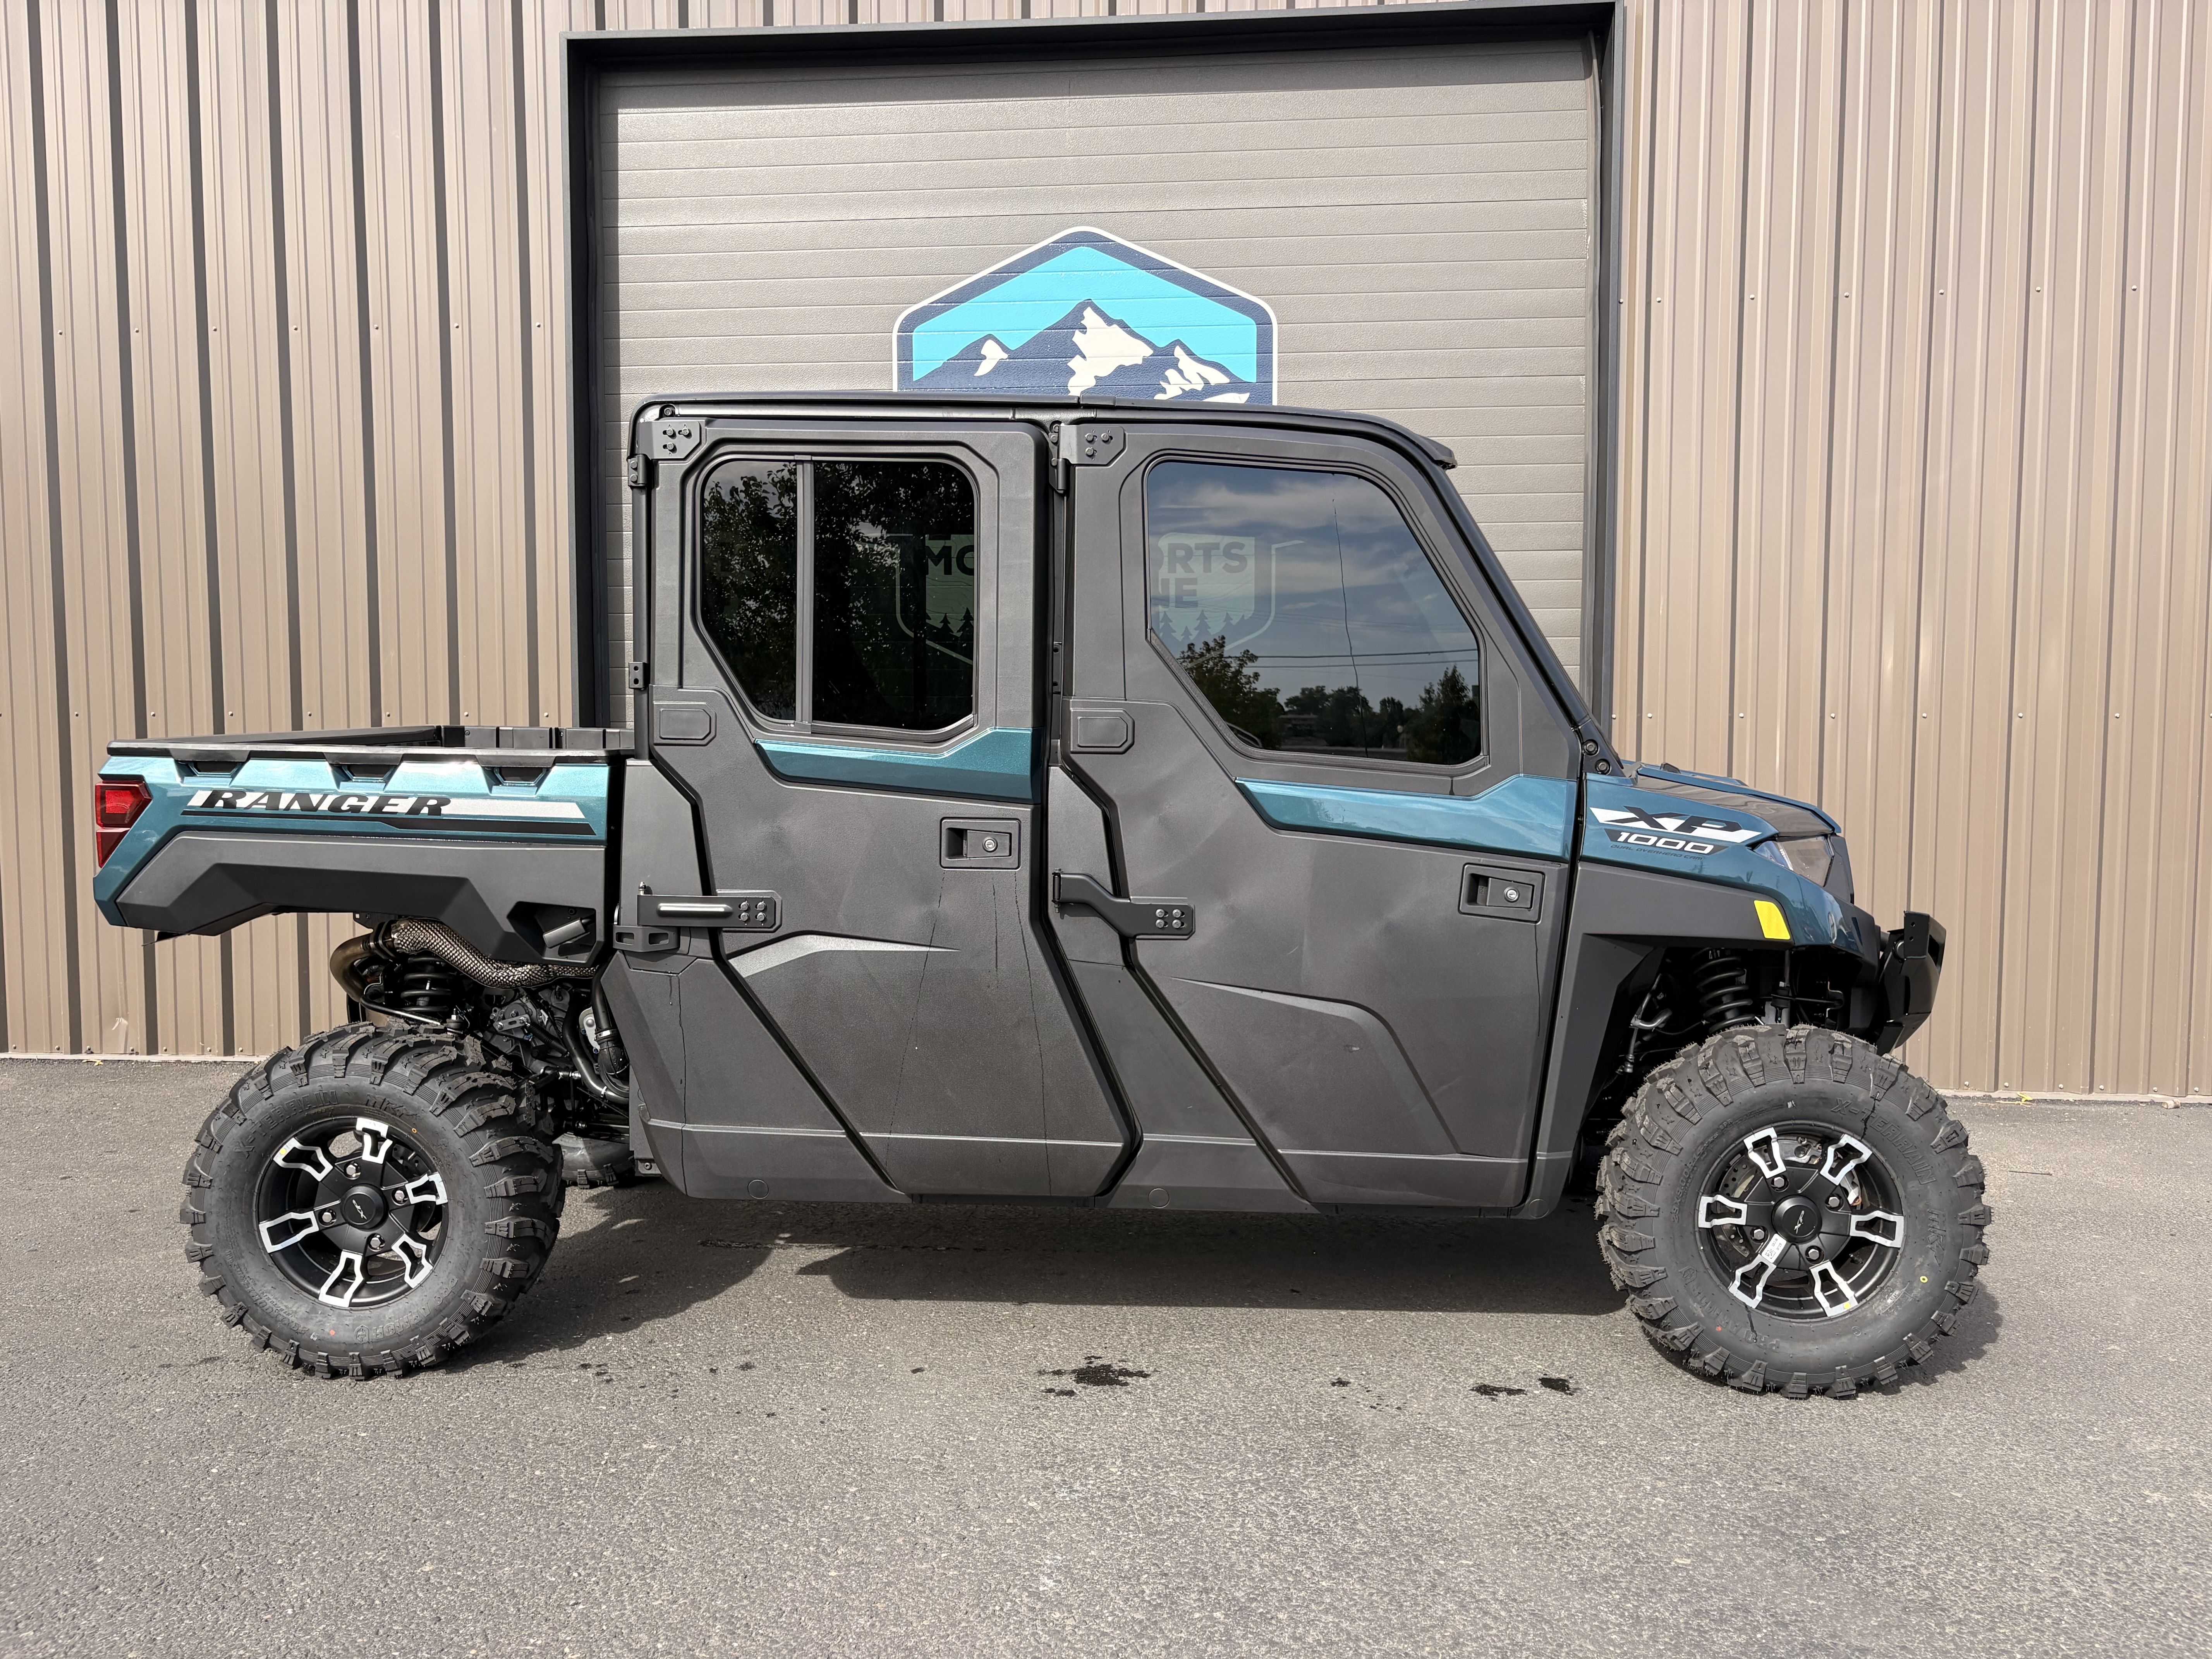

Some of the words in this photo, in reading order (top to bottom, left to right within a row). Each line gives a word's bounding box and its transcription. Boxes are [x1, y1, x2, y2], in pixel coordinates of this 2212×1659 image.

[1158, 541, 1248, 574] RTS
[200, 790, 451, 816] RANGER
[1604, 805, 1743, 833] XP
[1617, 832, 1714, 854] 1000
[1636, 848, 1683, 857] OVERHEAD
[1830, 1097, 1936, 1185] X-TERRAIN
